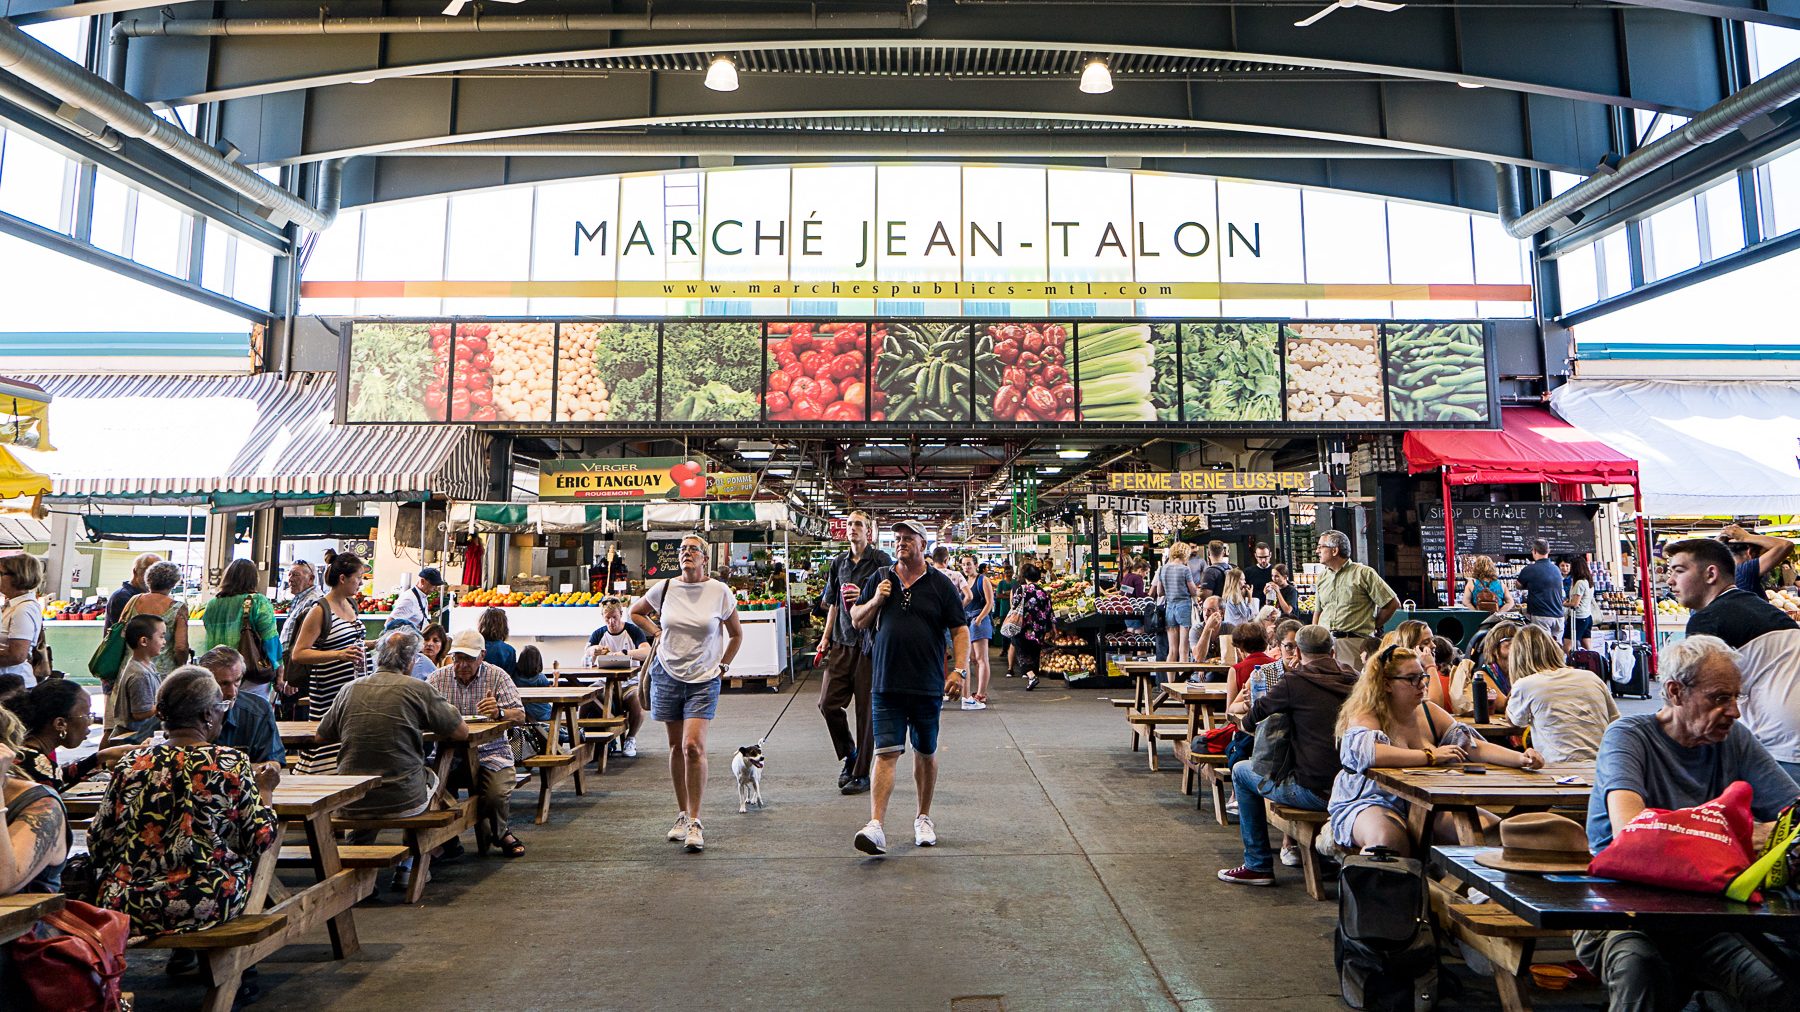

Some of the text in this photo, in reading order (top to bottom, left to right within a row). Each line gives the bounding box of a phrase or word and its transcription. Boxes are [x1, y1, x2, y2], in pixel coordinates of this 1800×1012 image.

[574, 210, 1261, 268] MARCHÉ JEAN-TALON
[663, 281, 1172, 297] www.marchespublics-mtl.com
[580, 462, 639, 472] VERGER
[556, 474, 662, 489] ÉRIC TANGUAY
[727, 474, 753, 485] POMME
[1110, 472, 1305, 489] FERME RENE LUSSIER
[1097, 495, 1279, 515] PETITS FRUITS DU QC
